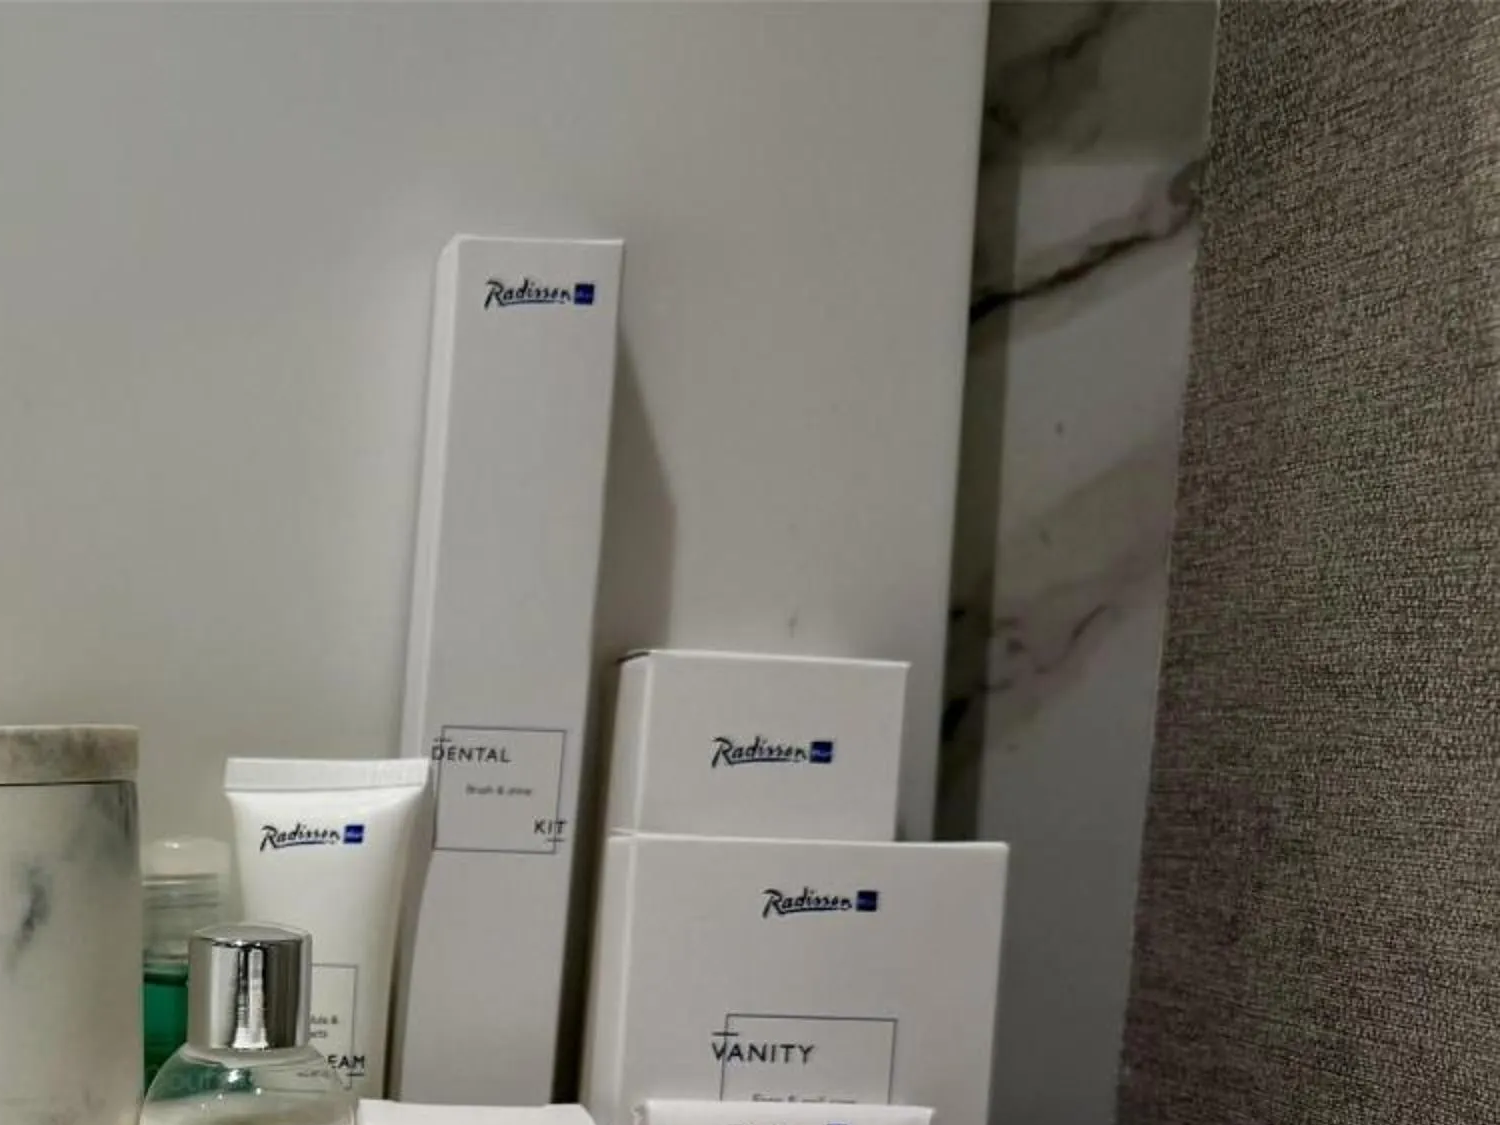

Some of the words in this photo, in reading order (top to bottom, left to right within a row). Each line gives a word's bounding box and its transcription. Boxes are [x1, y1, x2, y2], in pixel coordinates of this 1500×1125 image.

[484, 280, 572, 309] Radisson
[431, 745, 512, 763] DENTAL
[711, 735, 808, 768] Radisson
[260, 823, 340, 852] Radisson
[533, 819, 568, 835] KIT
[762, 887, 852, 918] Radisson
[327, 1055, 366, 1070] EAM
[711, 1041, 815, 1065] VANITY
